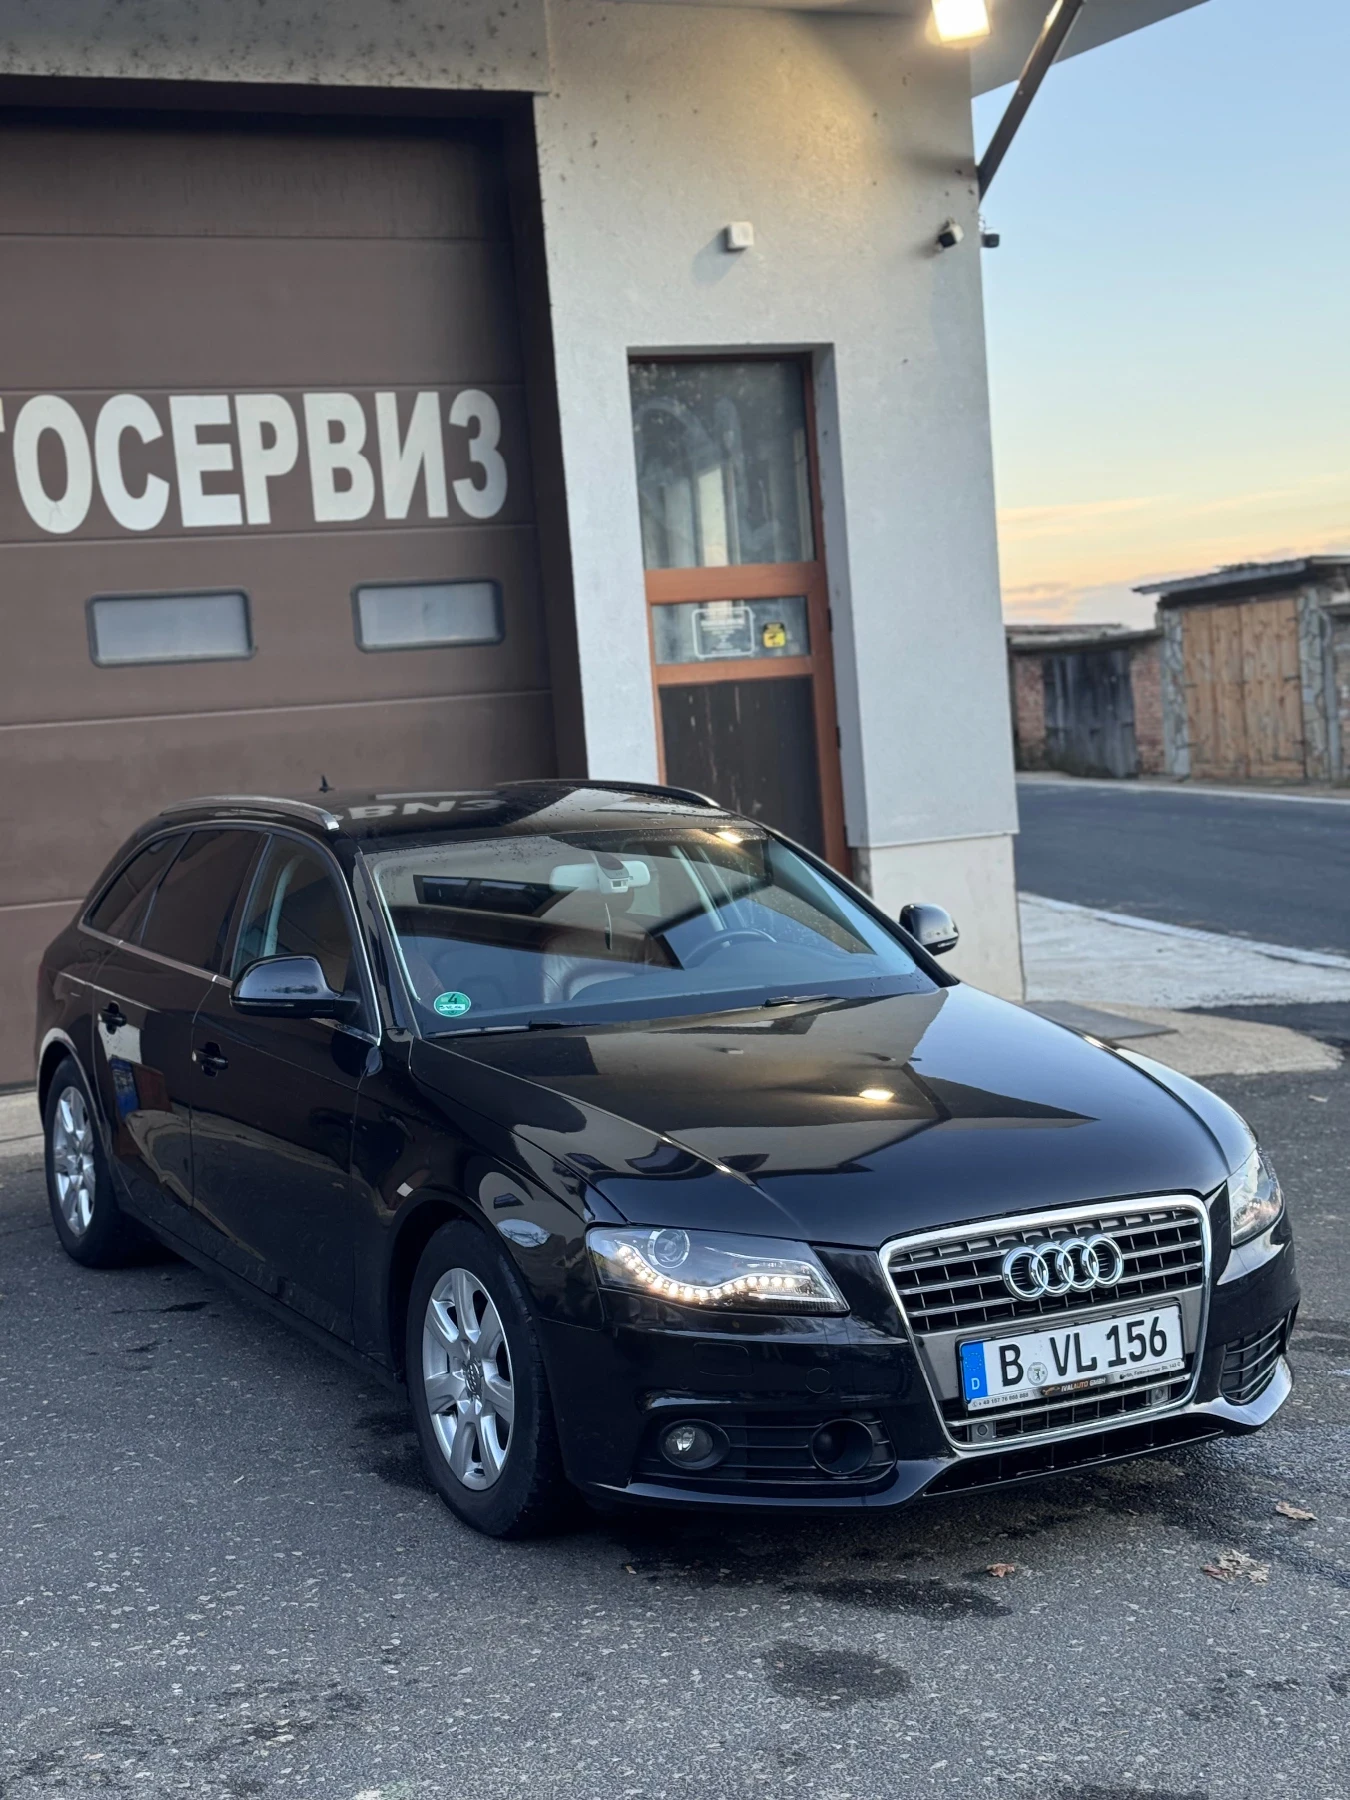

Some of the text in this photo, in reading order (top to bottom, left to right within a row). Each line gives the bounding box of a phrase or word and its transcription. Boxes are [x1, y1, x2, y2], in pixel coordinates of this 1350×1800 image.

[0, 389, 508, 534] ОСЕРВИЗ
[448, 993, 458, 1004] 4
[998, 1343, 1024, 1387] B
[1049, 1332, 1098, 1377] VL
[1106, 1316, 1167, 1368] 156
[971, 1378, 980, 1390] D
